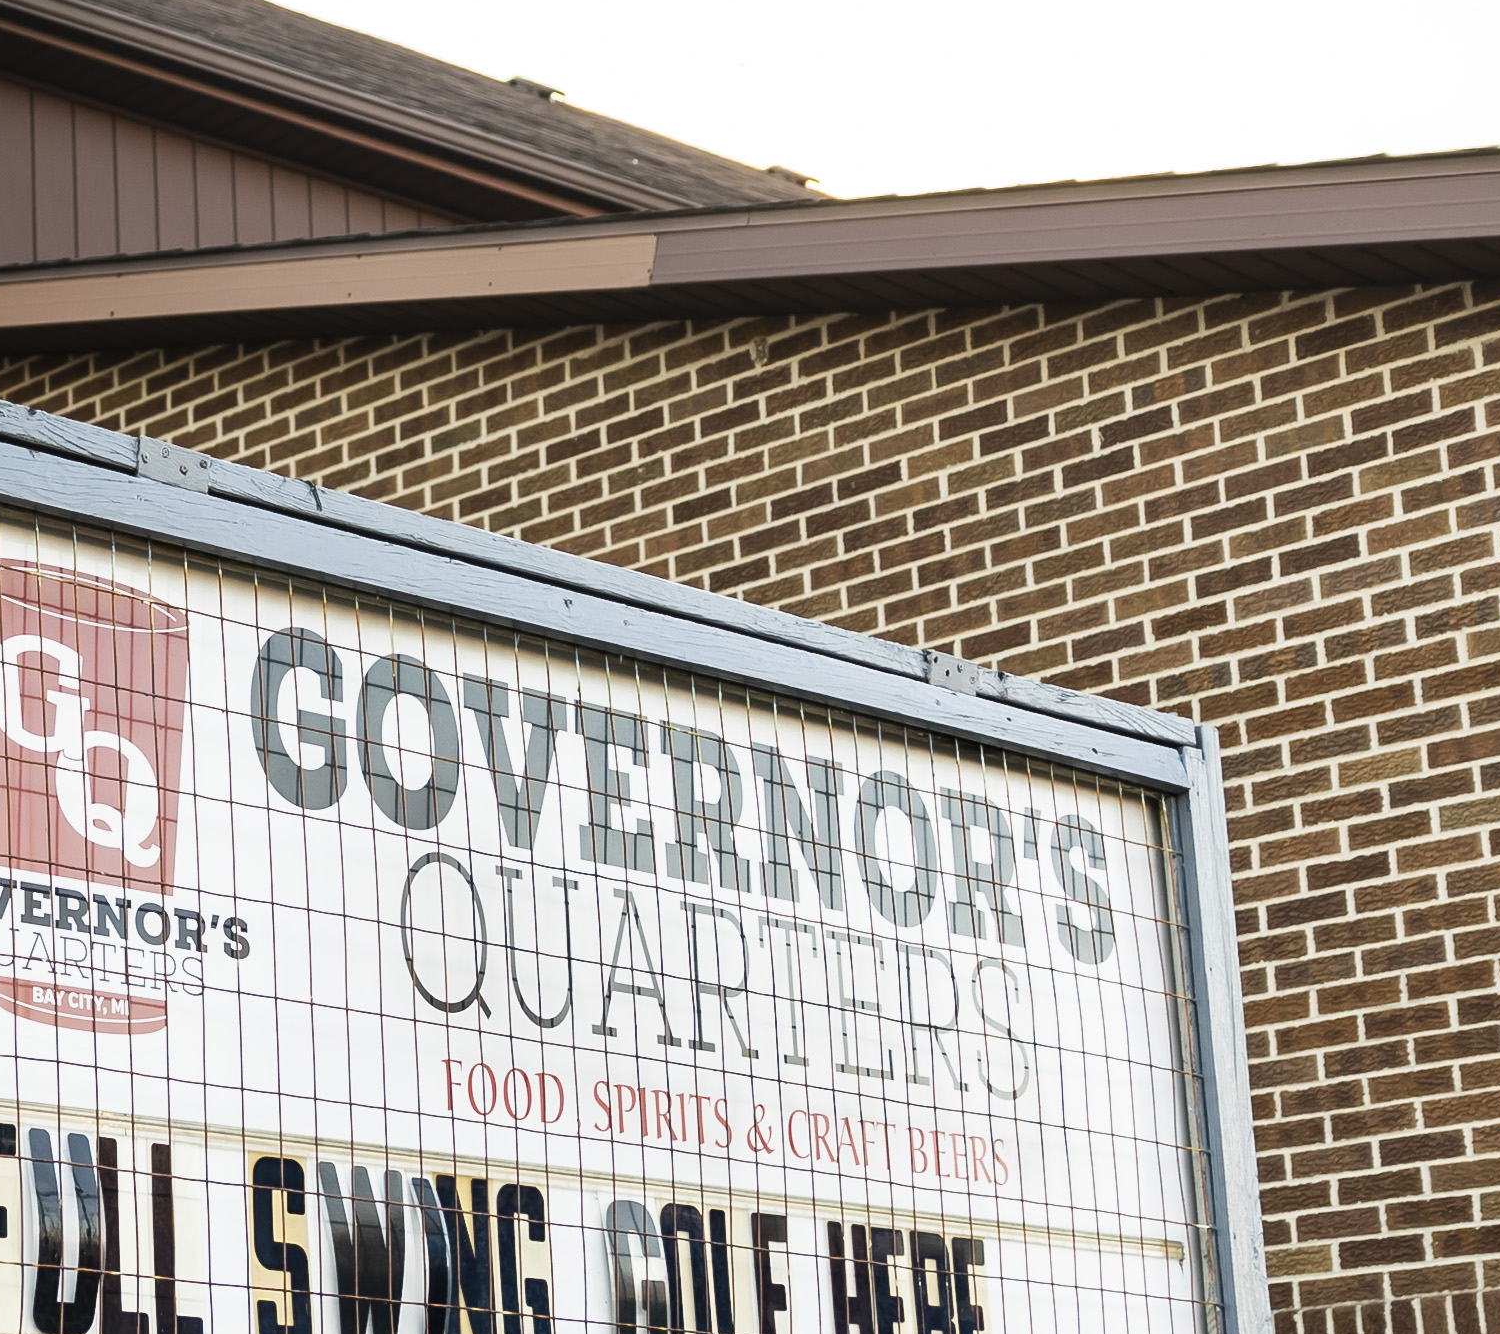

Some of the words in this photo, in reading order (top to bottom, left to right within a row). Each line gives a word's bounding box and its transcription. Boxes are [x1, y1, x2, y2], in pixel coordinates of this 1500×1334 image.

[250, 626, 1117, 965] GOVERNOR'S
[32, 986, 67, 1008] BAY
[67, 991, 108, 1014] CITY,
[110, 998, 131, 1016] MI
[401, 850, 1031, 1101] QUARTERS
[593, 1080, 733, 1149] SPIRITS
[746, 1104, 776, 1155] &
[787, 1108, 897, 1172] CRAFT
[905, 1126, 1010, 1187] BEERS
